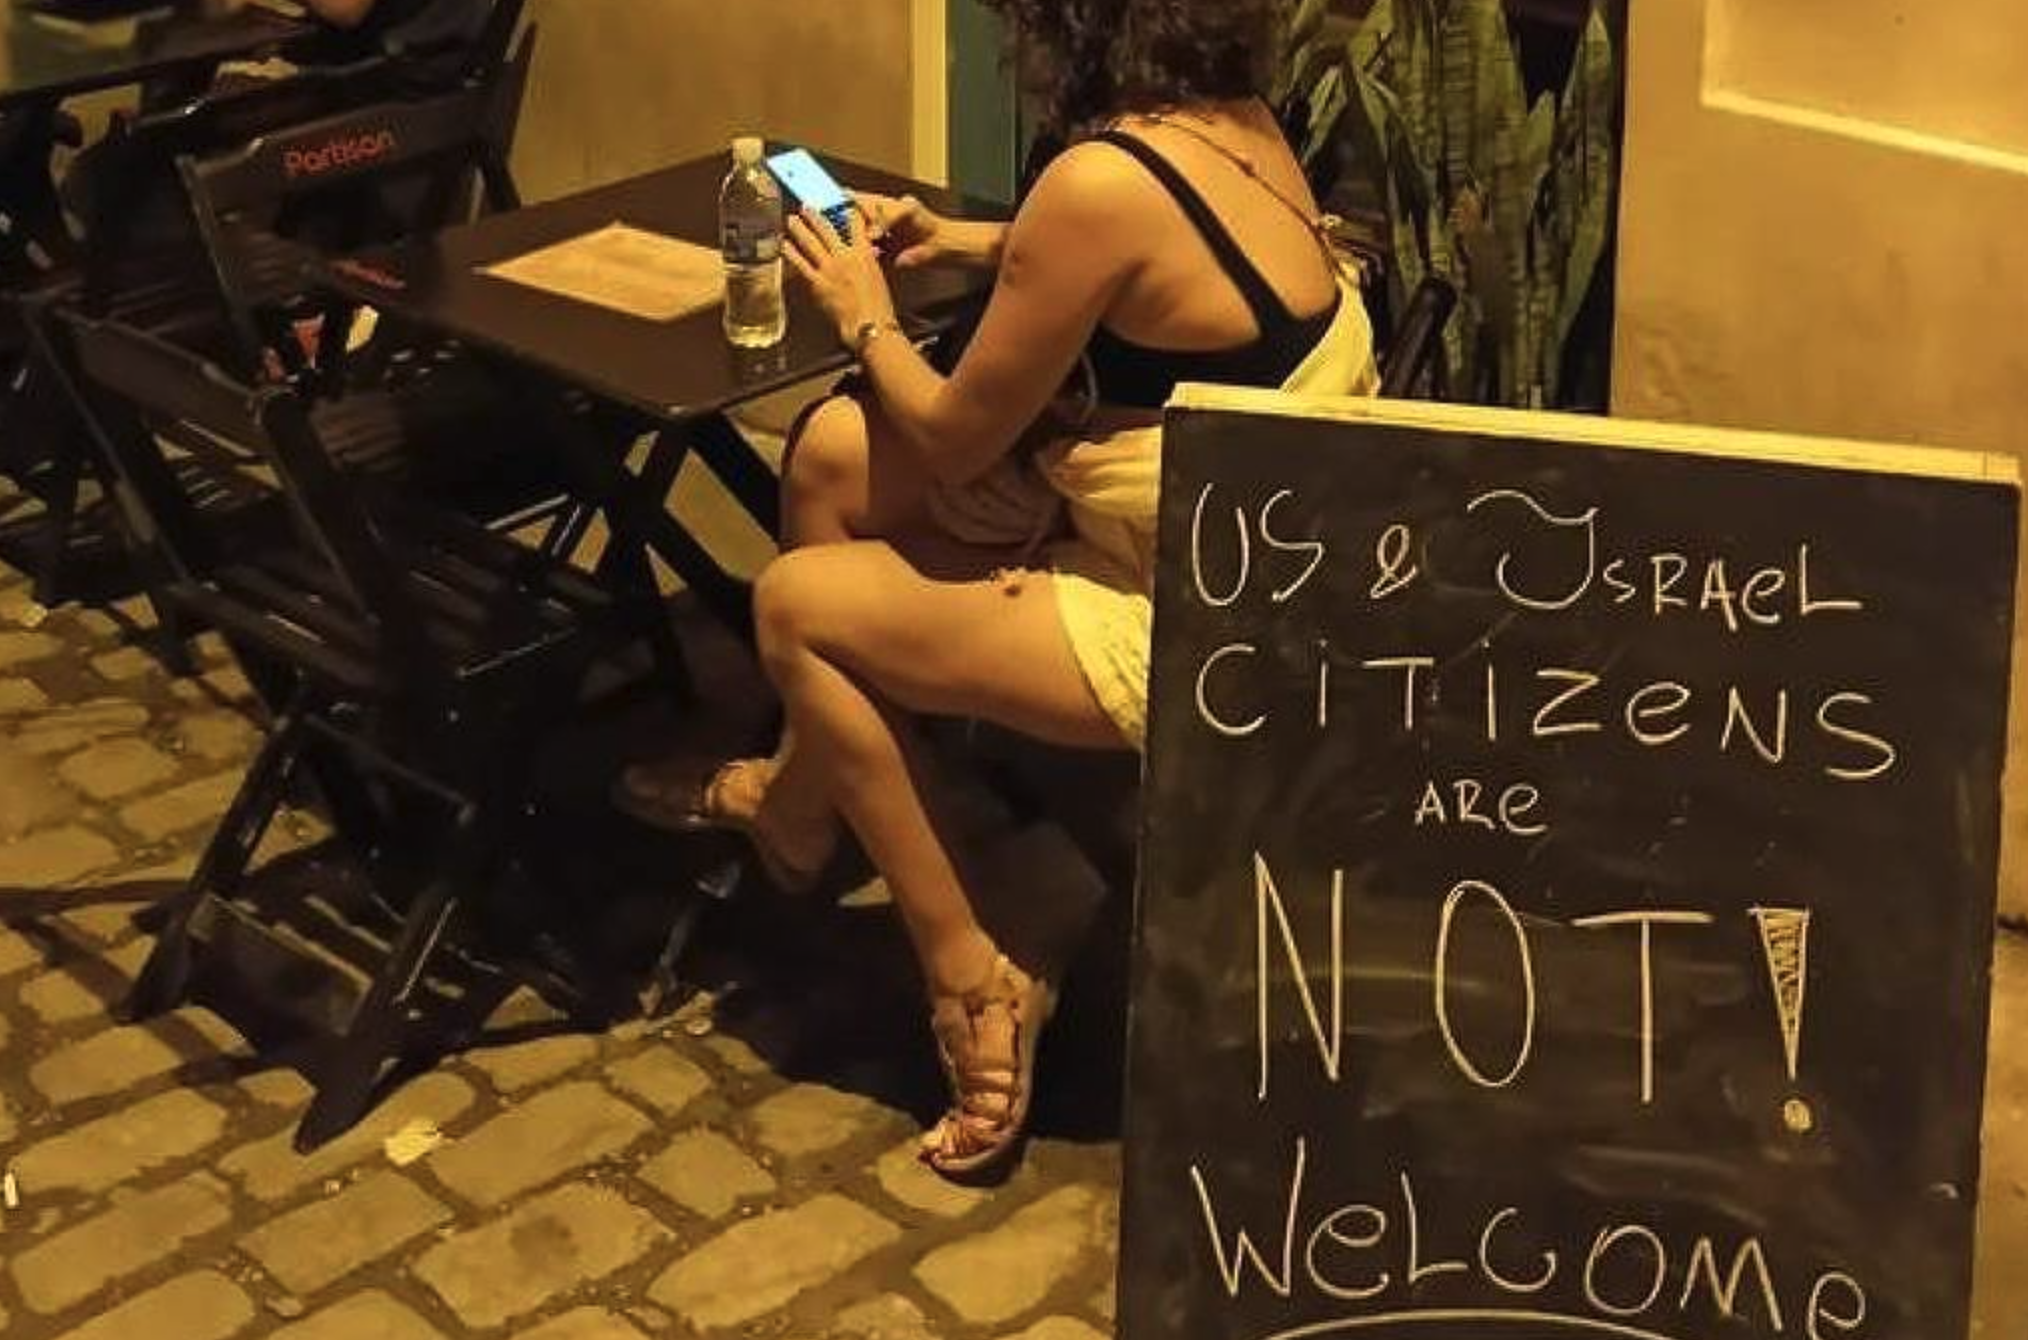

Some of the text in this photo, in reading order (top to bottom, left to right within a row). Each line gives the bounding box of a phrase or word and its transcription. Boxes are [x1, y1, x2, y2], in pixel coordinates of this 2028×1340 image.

[1192, 482, 1323, 606] US
[1370, 523, 1416, 599] &
[1255, 850, 1813, 1133] NOT!
